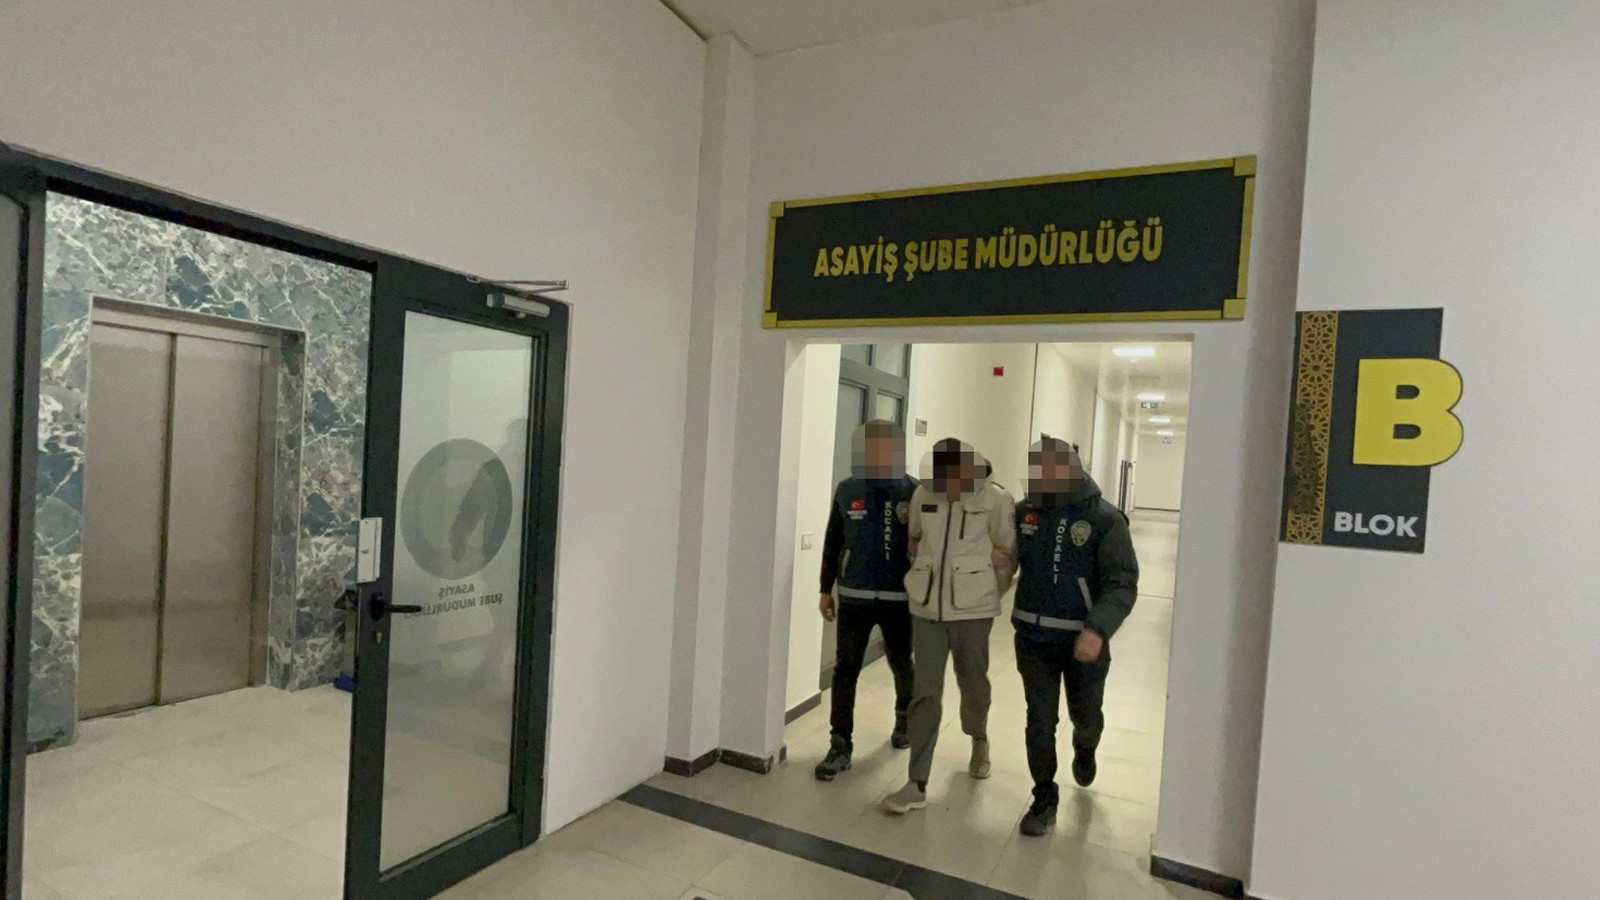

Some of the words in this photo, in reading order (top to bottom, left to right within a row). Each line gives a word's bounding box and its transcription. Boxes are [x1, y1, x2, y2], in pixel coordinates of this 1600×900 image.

[814, 236, 899, 282] ASAYİŞ
[903, 237, 968, 282] ŞUBE
[975, 217, 1163, 270] MÜDÜRLÜĞÜ
[1353, 358, 1463, 467] B
[1334, 511, 1418, 538] BLOK
